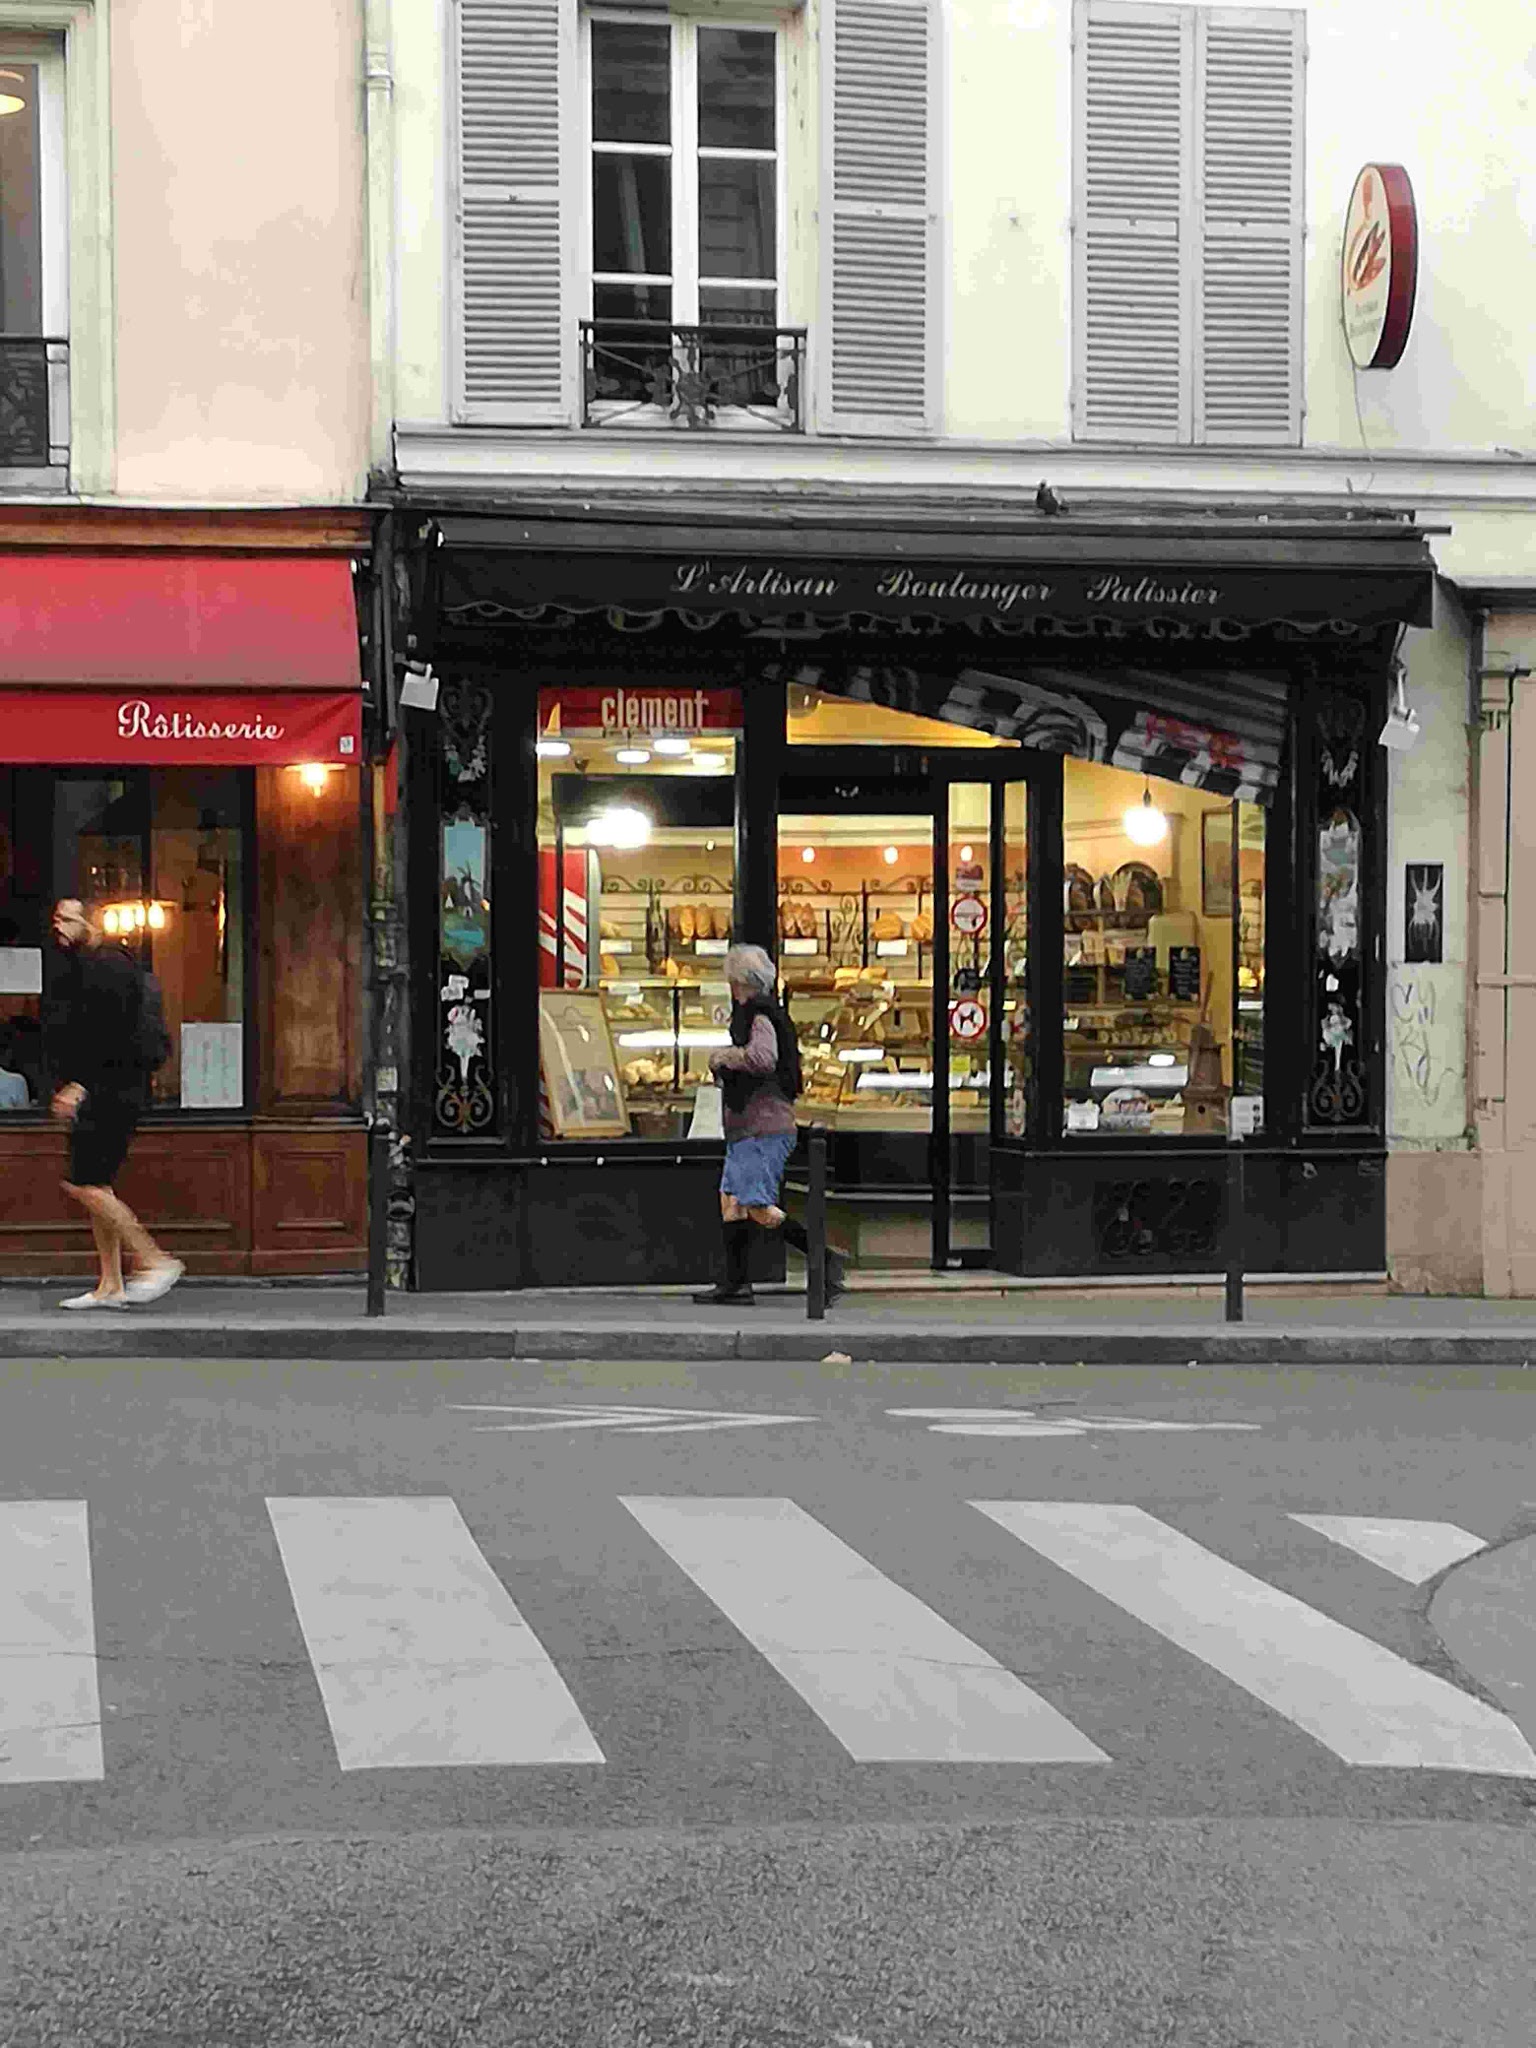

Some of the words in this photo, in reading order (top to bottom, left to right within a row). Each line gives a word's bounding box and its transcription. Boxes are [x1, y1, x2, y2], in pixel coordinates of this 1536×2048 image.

[672, 561, 838, 596] L'Artisan
[876, 568, 1053, 611] Boulanger
[117, 700, 284, 739] Rôtisserie
